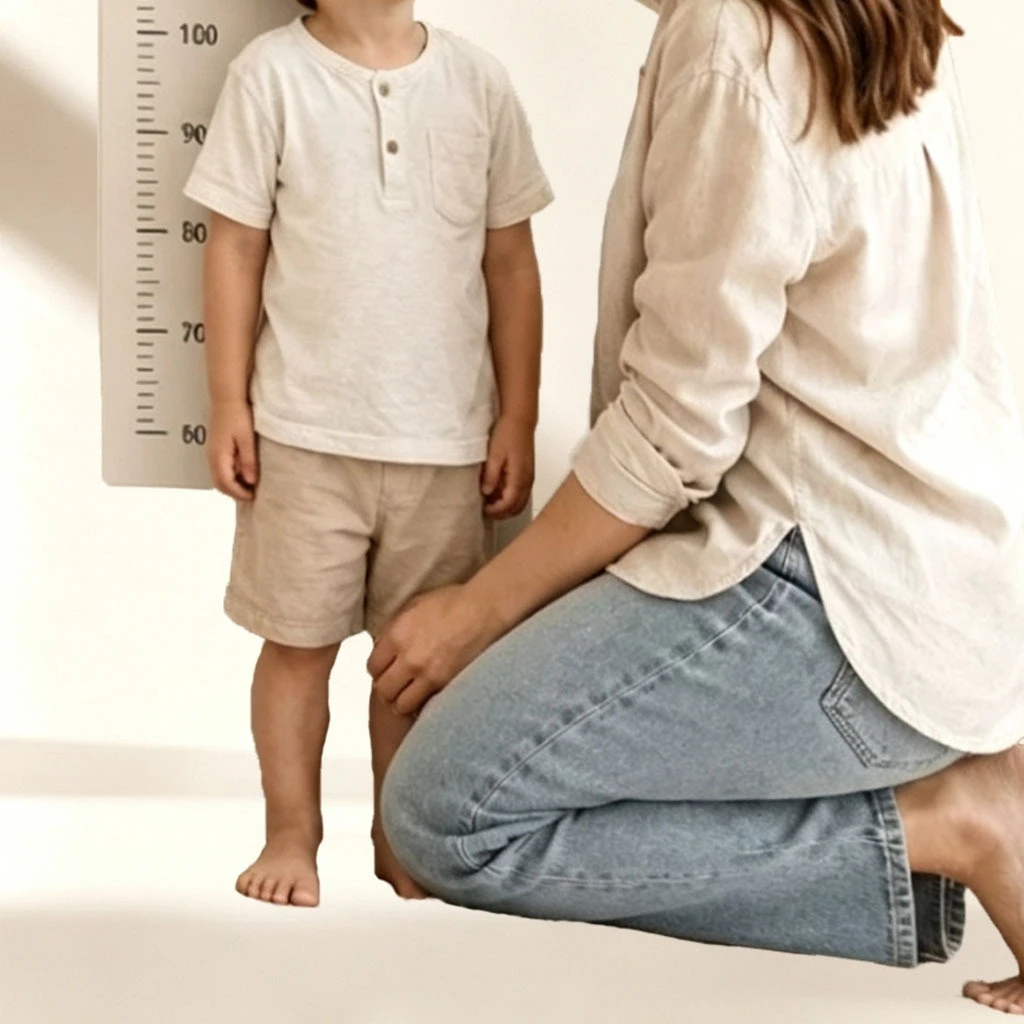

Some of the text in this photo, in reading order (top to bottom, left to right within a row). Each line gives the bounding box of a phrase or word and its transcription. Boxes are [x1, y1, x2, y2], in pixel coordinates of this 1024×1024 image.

[179, 23, 219, 46] 100
[181, 122, 208, 146] 90
[182, 220, 208, 244] 80
[182, 321, 207, 344] 70
